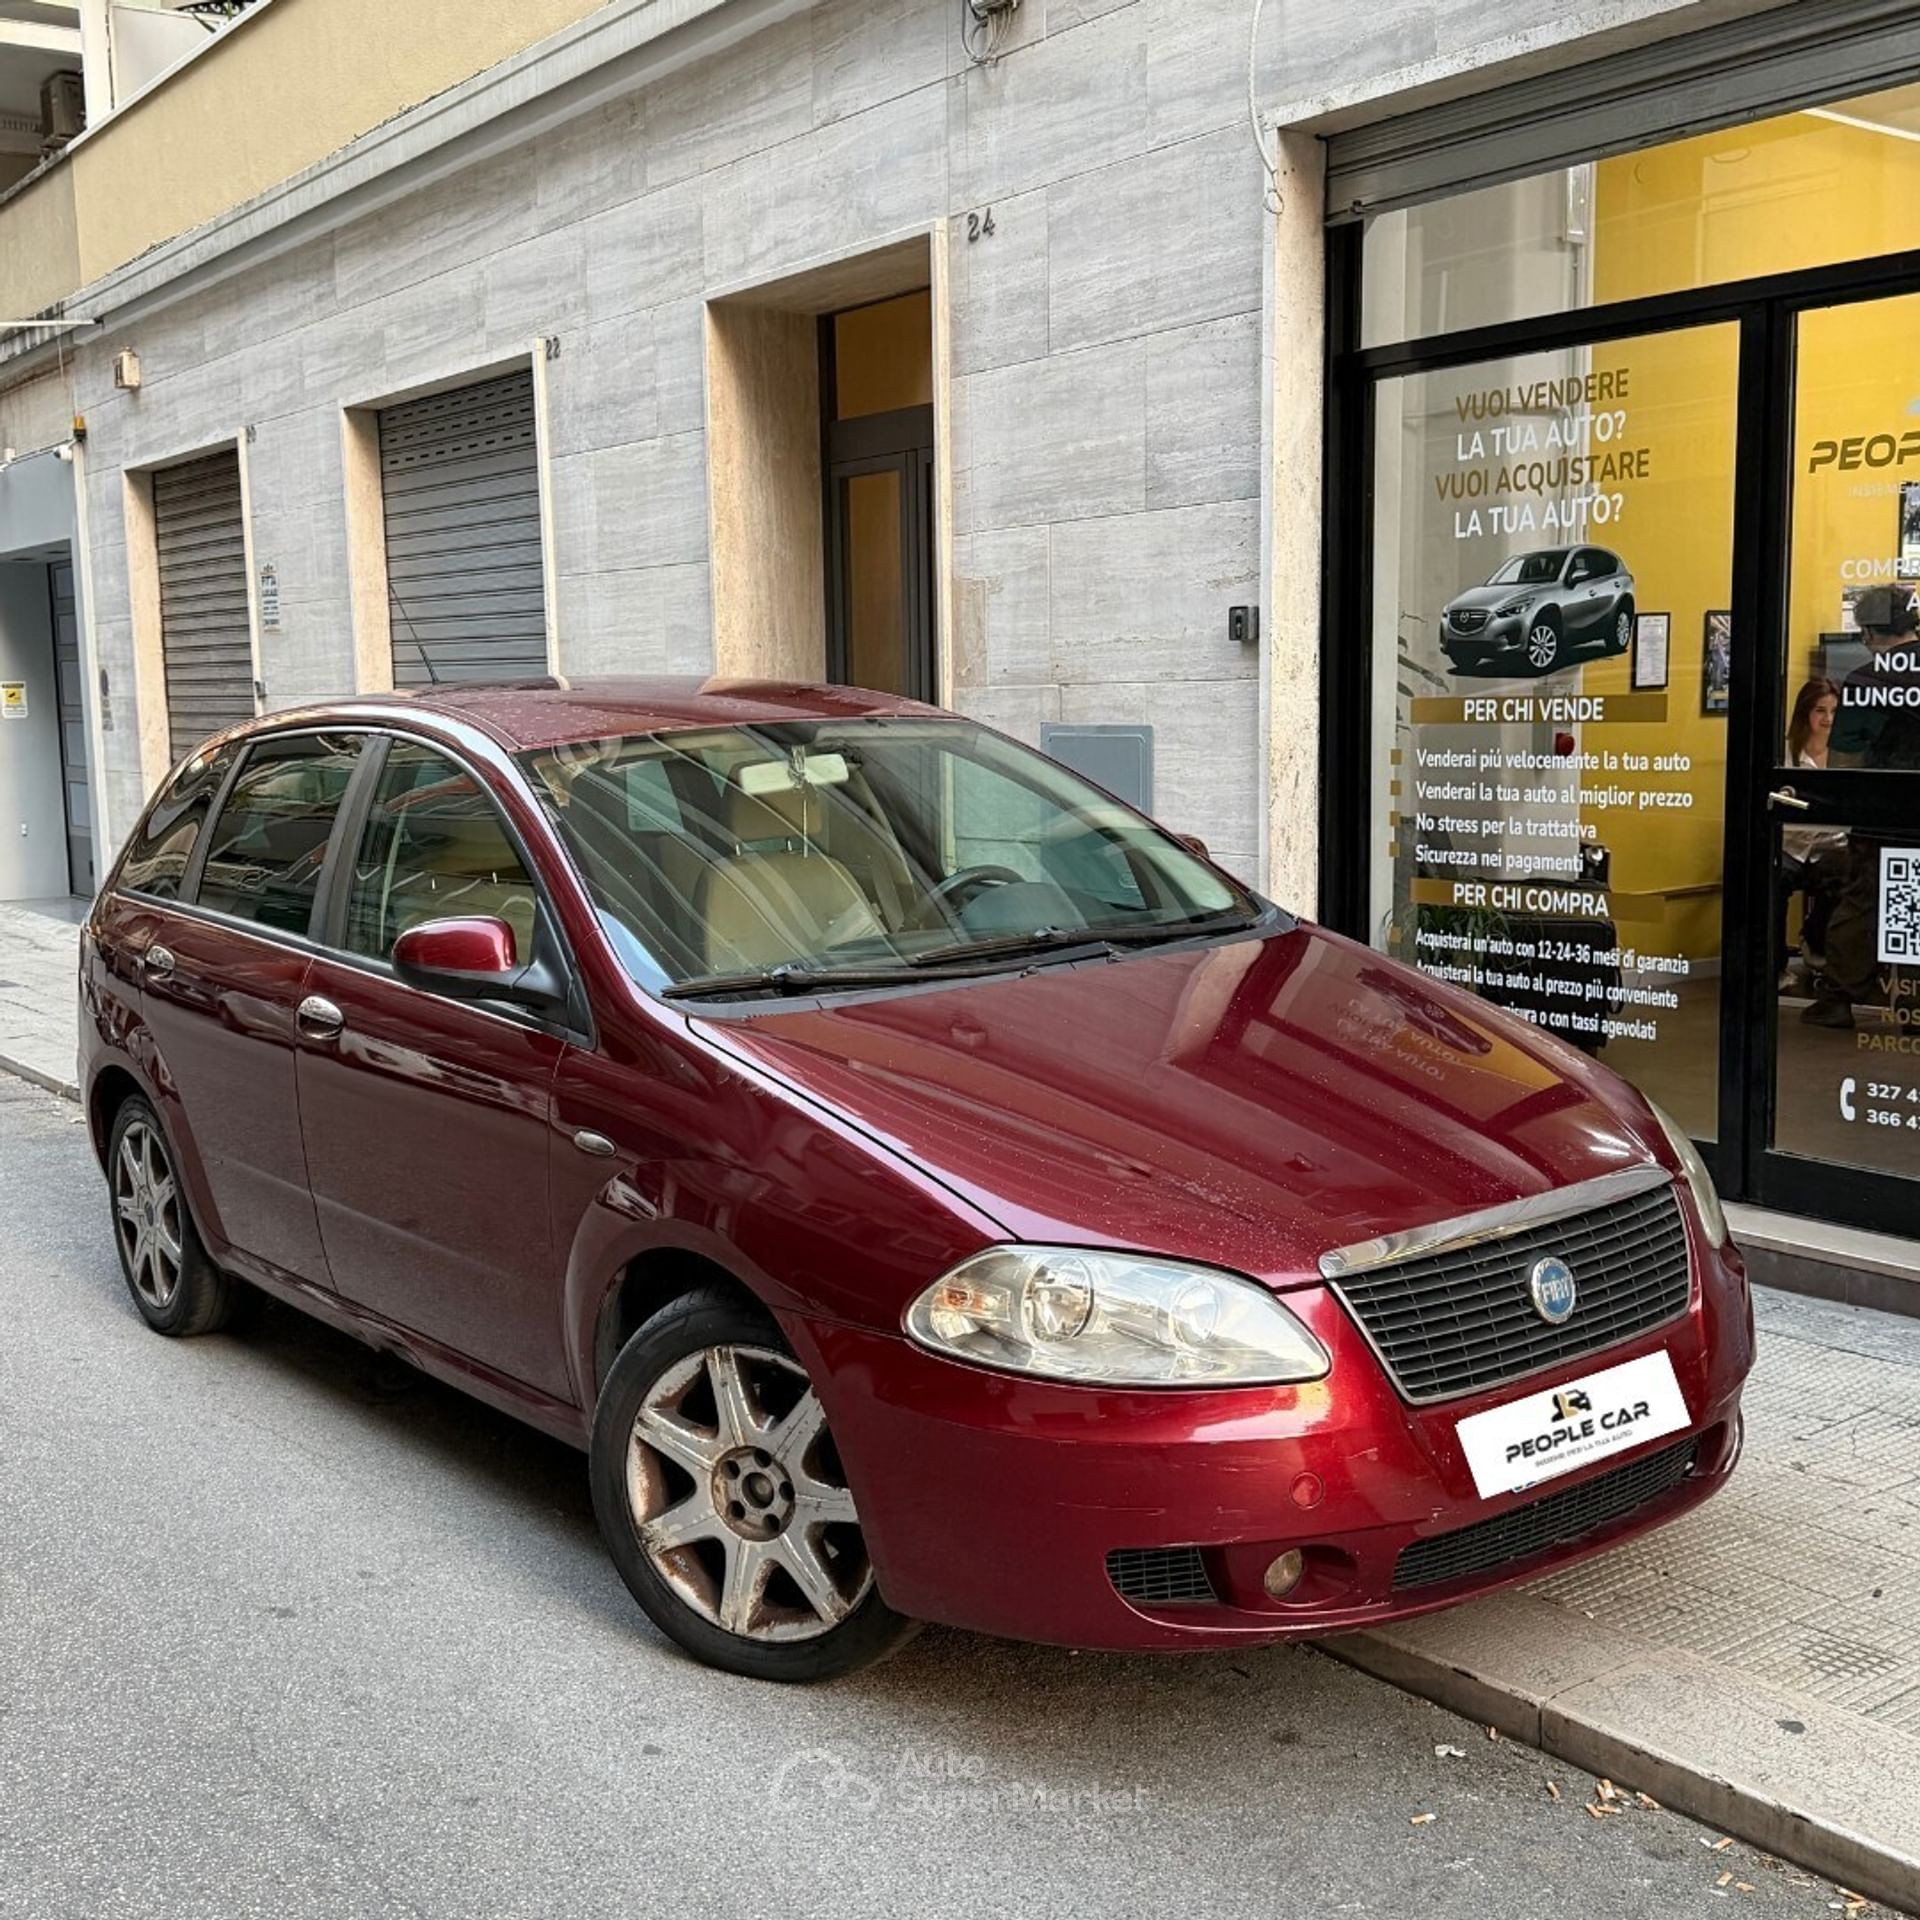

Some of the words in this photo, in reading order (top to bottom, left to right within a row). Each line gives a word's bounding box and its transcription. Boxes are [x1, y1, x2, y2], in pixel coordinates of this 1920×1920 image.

[967, 207, 995, 243] 24
[545, 336, 560, 361] 22
[1456, 389, 1509, 423] VUOI
[1518, 368, 1629, 411] VENDERE
[1457, 432, 1483, 461] LA
[1491, 424, 1538, 454] TUA
[1545, 410, 1626, 447] AUTO?
[1808, 430, 1920, 474] PEOP
[1435, 470, 1489, 501] VUOI
[1496, 449, 1650, 496] ACQUISTARE
[1455, 509, 1482, 538] LA
[1488, 503, 1535, 535] TUA
[1542, 493, 1624, 528] AUTO?
[1874, 652, 1920, 672] NOL
[1464, 699, 1497, 721] PER
[1503, 699, 1533, 721] CHI
[1539, 698, 1604, 721] VENDE
[1842, 686, 1920, 707] LUNGO
[1416, 748, 1476, 767] Venderai
[1505, 750, 1599, 770] velocemente
[1604, 750, 1617, 770] la
[1622, 752, 1649, 771] tua
[1653, 752, 1690, 771] auto
[1416, 781, 1476, 800] Venderai
[1480, 782, 1493, 801] la
[1497, 784, 1519, 801] tua
[1523, 785, 1557, 803] auto
[1561, 784, 1574, 803] al
[1580, 784, 1635, 809] miglior
[1639, 791, 1693, 810] prezzo
[1416, 812, 1434, 831] No
[1438, 815, 1478, 833] stress
[1482, 820, 1505, 838] per
[1509, 816, 1522, 835] la
[1526, 818, 1597, 839] trattativa
[1415, 844, 1477, 865] Sicurezza
[1481, 848, 1501, 867] nei
[1505, 853, 1584, 873] pagamenti
[1453, 883, 1487, 906] PER
[1491, 886, 1521, 909] CHI
[1525, 889, 1609, 917] COMPRA
[1415, 927, 1471, 951] Acquisterai
[1473, 934, 1514, 955] un'auto
[1516, 943, 1535, 958] con
[1537, 940, 1590, 964] 12-24-36
[1593, 947, 1620, 967] mesi
[1622, 949, 1635, 968] di
[1636, 953, 1690, 974] garanzia
[1474, 965, 1483, 983] la
[1486, 968, 1503, 986] tua
[1506, 973, 1530, 990] auto
[1533, 973, 1543, 991] al
[1546, 977, 1583, 997] prezzo
[1606, 985, 1679, 1008] conveniente
[1539, 1011, 1546, 1025] o
[1549, 1011, 1569, 1028] con
[1572, 1012, 1599, 1032] tassi
[1602, 1019, 1657, 1040] agevolati
[1866, 1083, 1901, 1100] 327
[1906, 1088, 1920, 1103] 4
[1866, 1109, 1901, 1127] 366
[1906, 1115, 1920, 1130] 4
[1505, 1419, 1595, 1463] PEOPLE
[1600, 1401, 1650, 1430] CAR
